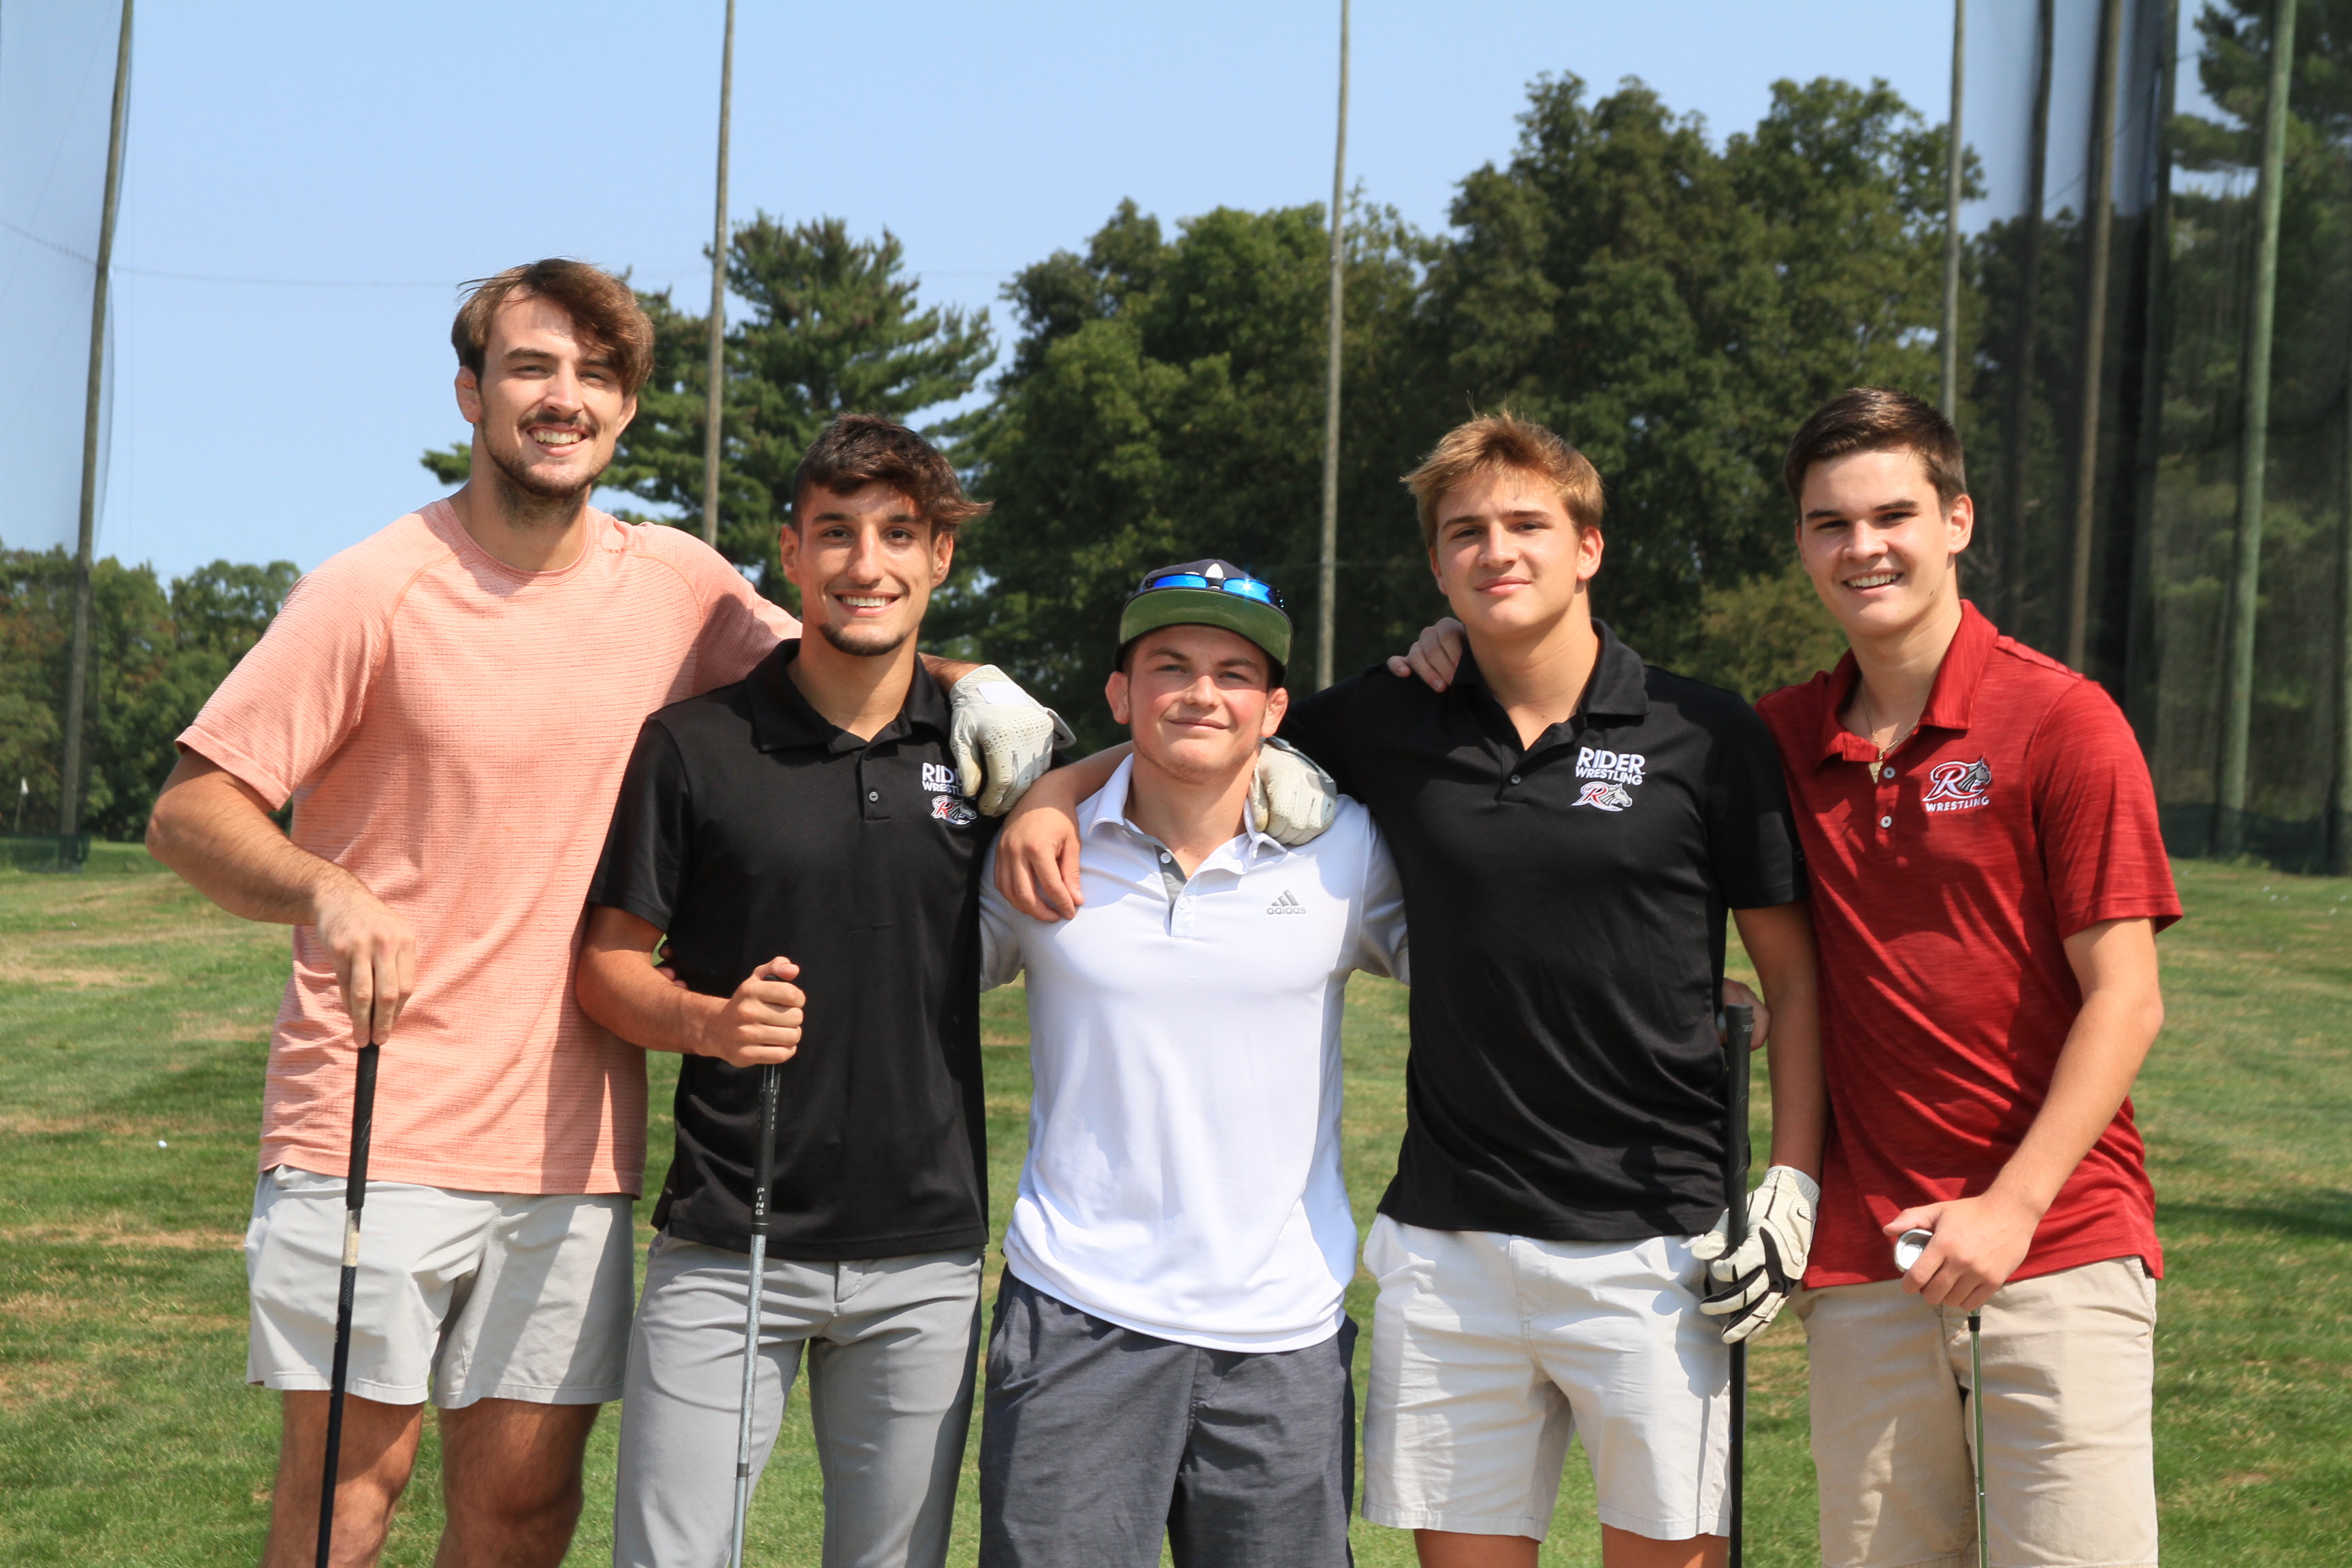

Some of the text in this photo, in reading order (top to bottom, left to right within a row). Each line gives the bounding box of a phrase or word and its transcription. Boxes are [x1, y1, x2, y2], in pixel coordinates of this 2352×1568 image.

[1576, 747, 1646, 775] RIDER
[921, 762, 963, 786] RID
[1575, 766, 1643, 785] WRESTLING
[921, 781, 977, 800] WRESTL
[1925, 796, 1991, 813] WRESTLING
[1266, 906, 1307, 915] adidas
[755, 1186, 765, 1215] PING
